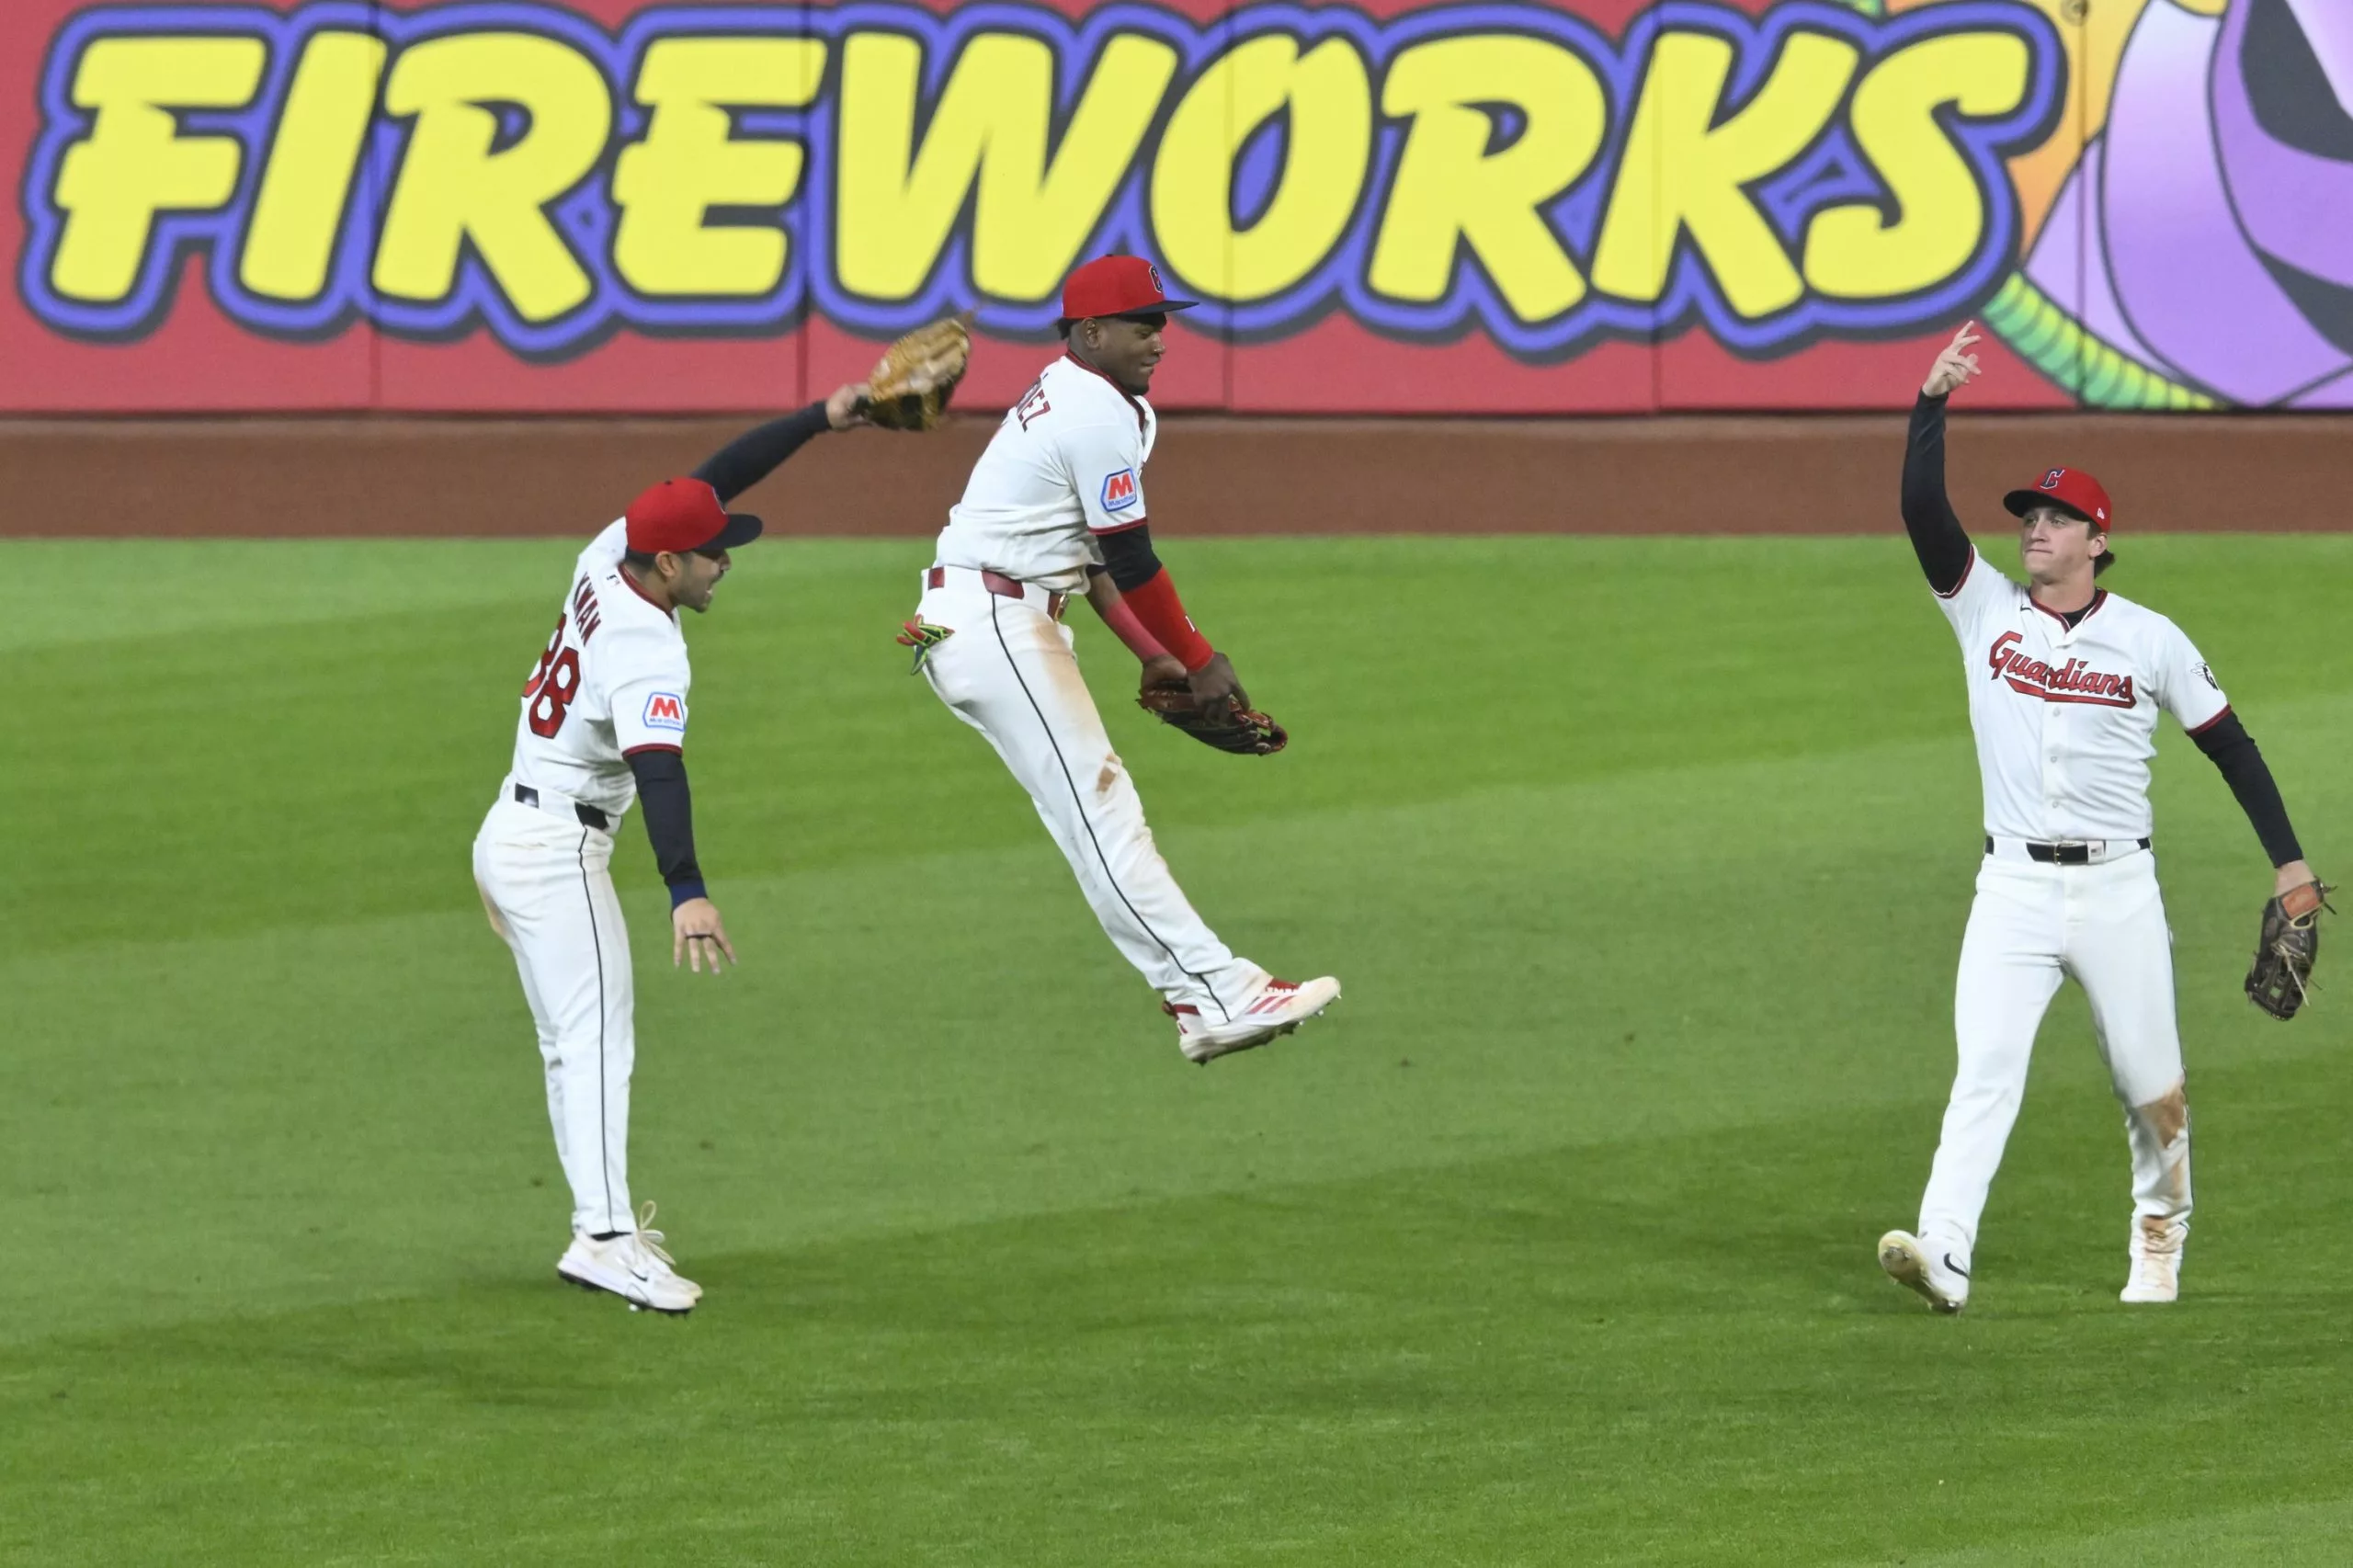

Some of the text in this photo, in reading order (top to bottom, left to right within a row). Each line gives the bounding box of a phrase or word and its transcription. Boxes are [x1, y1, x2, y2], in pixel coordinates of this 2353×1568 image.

[50, 30, 2031, 324] FIREWORKS
[1108, 473, 1133, 500] M
[1989, 628, 2134, 701] Guardians
[651, 697, 680, 720] M
